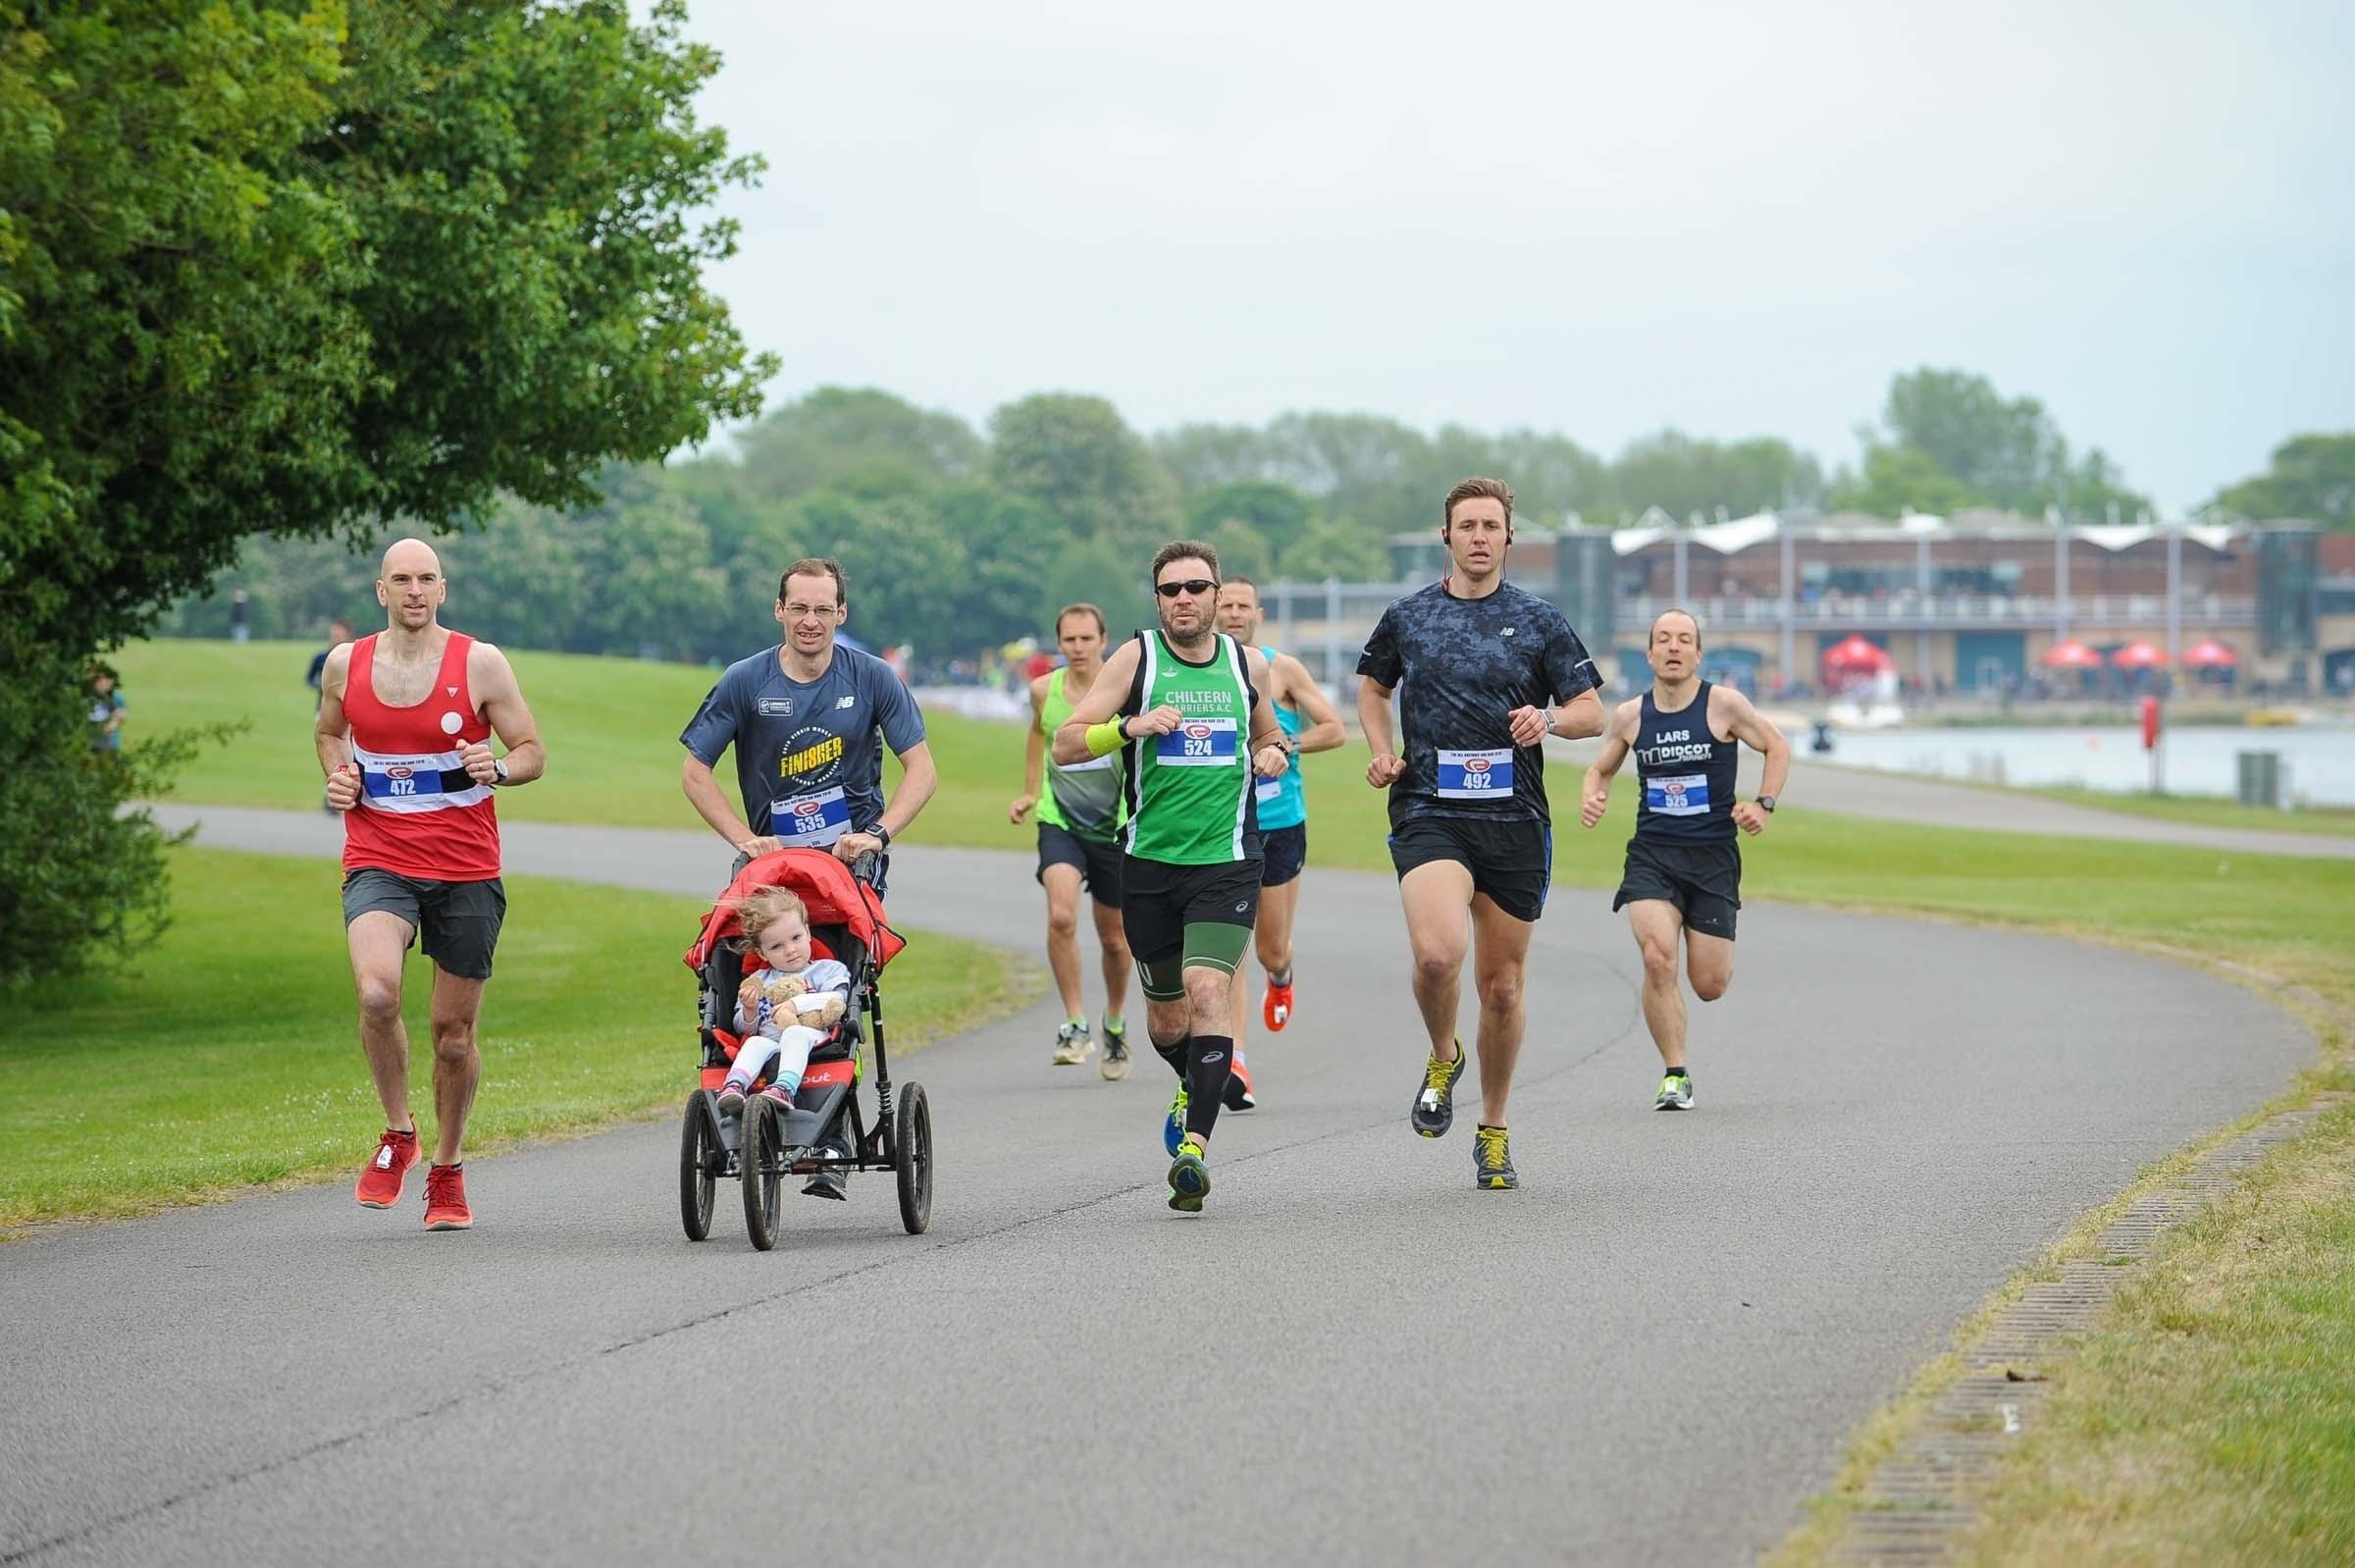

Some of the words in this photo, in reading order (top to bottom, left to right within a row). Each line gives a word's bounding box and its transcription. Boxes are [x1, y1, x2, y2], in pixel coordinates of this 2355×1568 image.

[1165, 691, 1231, 704] CHILTERN
[1656, 730, 1690, 744] LARS
[1184, 740, 1212, 756] 524
[1661, 744, 1711, 758] DIDCOT
[390, 779, 416, 796] 472
[1463, 772, 1492, 789] 492
[1664, 794, 1689, 808] 525
[794, 813, 826, 833] 535
